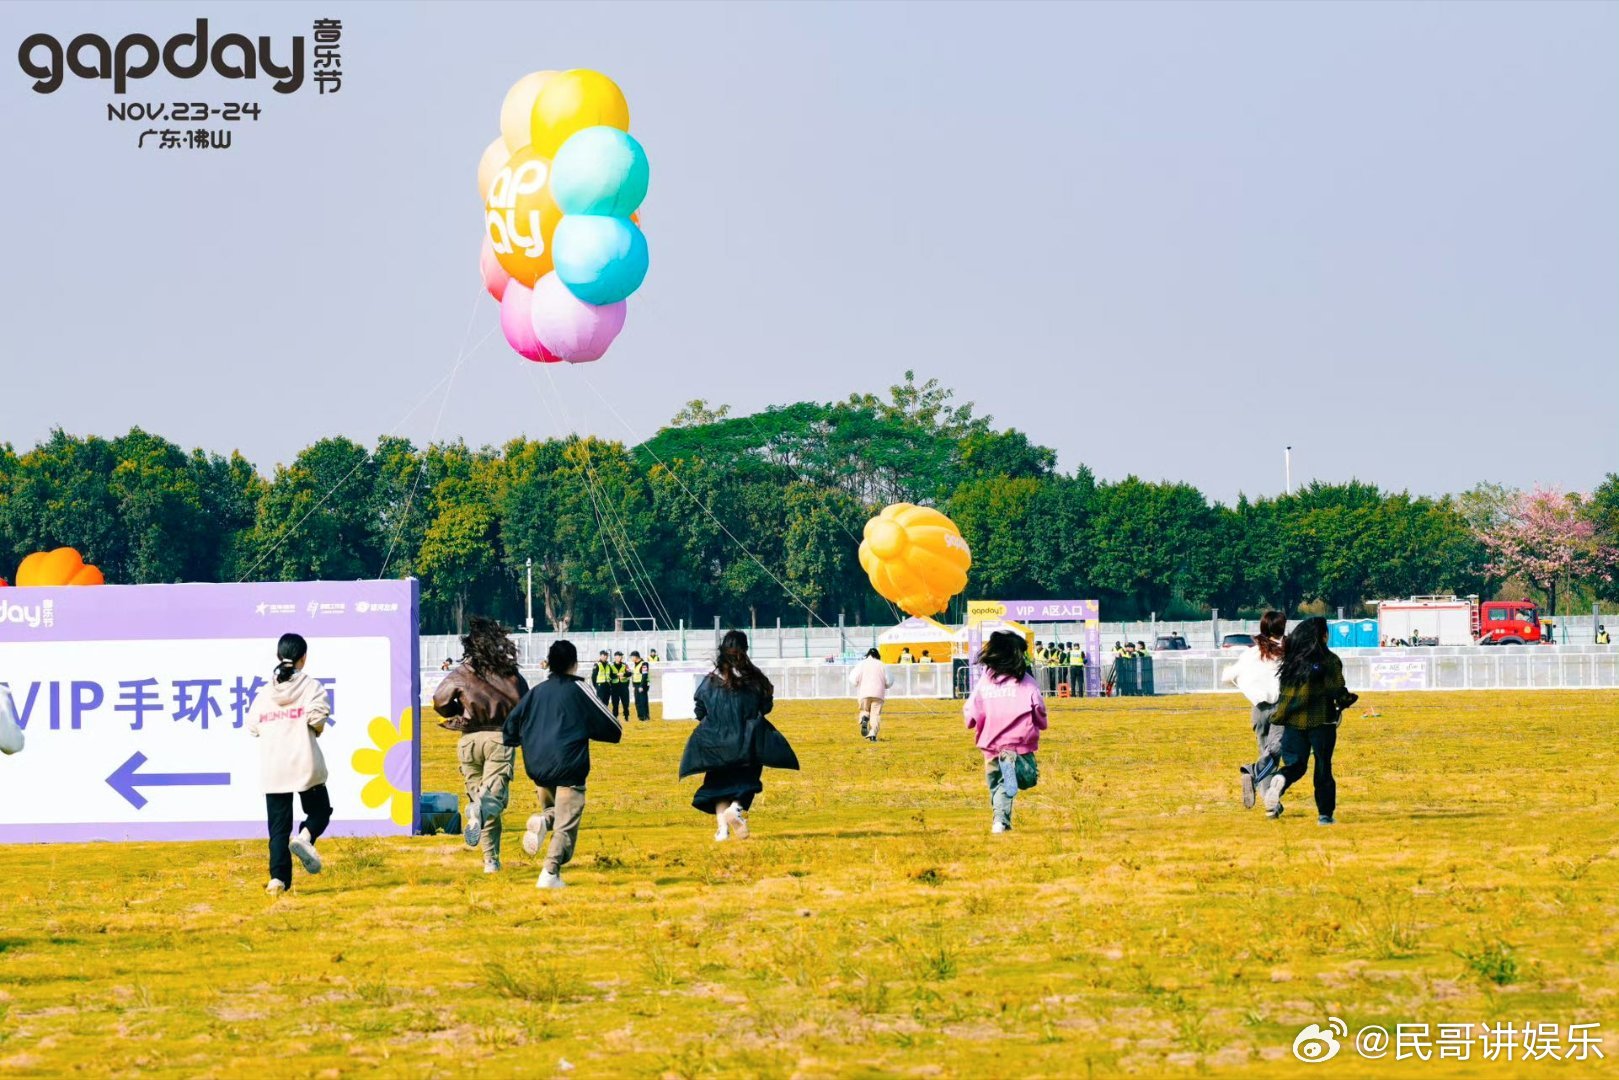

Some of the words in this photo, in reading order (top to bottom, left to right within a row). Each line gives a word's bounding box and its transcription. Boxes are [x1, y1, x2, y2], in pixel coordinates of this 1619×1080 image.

[484, 208, 545, 258] ay
[1016, 606, 1035, 616] VIP
[1042, 605, 1083, 616] A区入口
